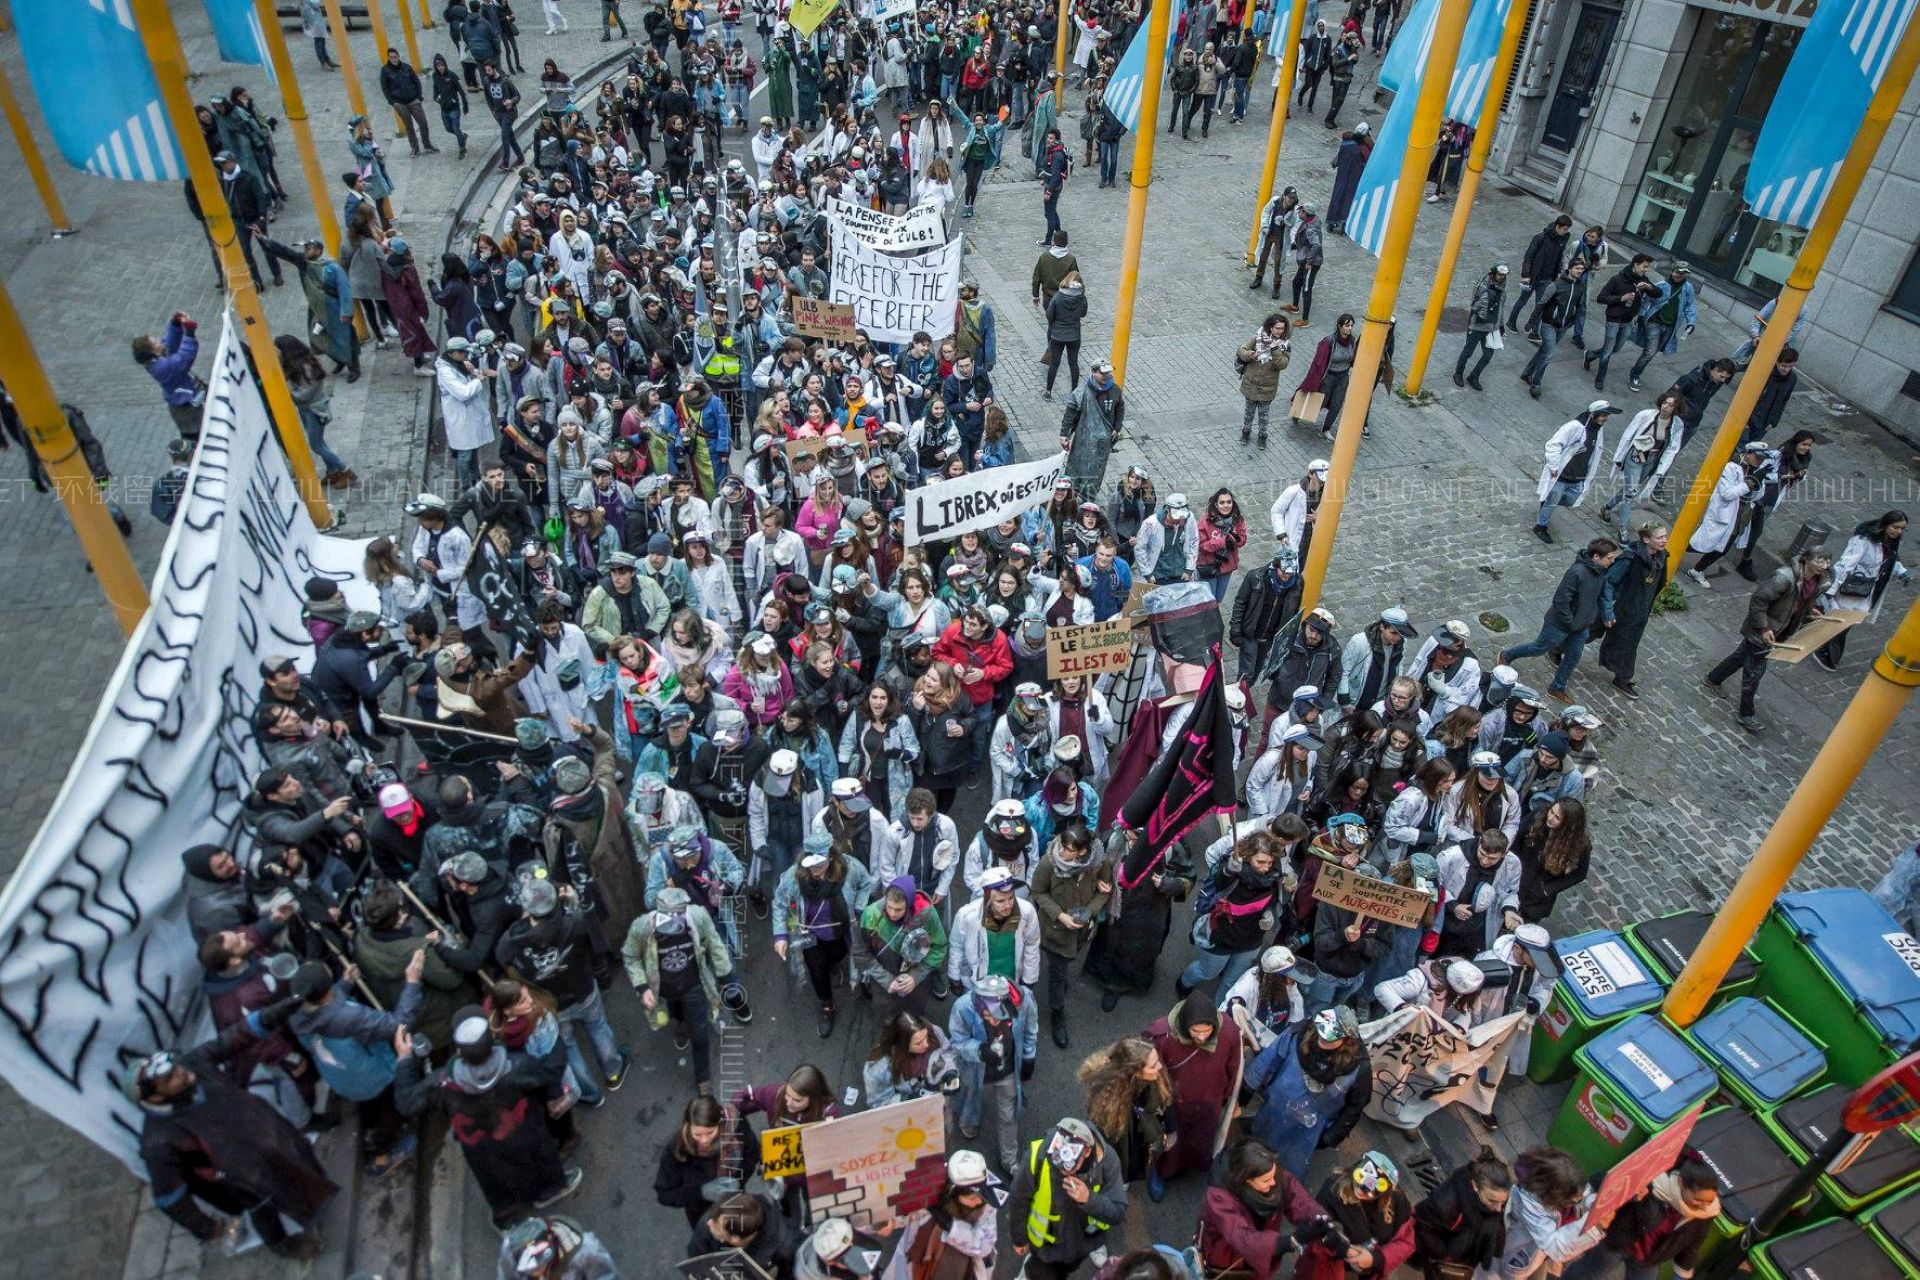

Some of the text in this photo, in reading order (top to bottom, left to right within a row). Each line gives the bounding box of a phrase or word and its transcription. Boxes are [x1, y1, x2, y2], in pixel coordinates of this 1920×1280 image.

[835, 201, 853, 216] LA
[908, 271, 949, 302] THE
[799, 300, 818, 312] ULB
[795, 310, 820, 325] PINK
[1050, 631, 1061, 641] IL
[1066, 626, 1087, 639] EST
[1105, 621, 1117, 631] LE
[1060, 640, 1077, 653] LE
[1083, 652, 1109, 670] EST
[1313, 888, 1336, 899] AUX
[1322, 864, 1345, 880] LA
[1401, 890, 1431, 905] DOIT
[1329, 879, 1343, 889] SE
[1563, 955, 1602, 996] GLAS
[1576, 950, 1614, 994] VERRE
[838, 1151, 889, 1174] SOYEZ
[854, 1164, 902, 1184] LIBRE
